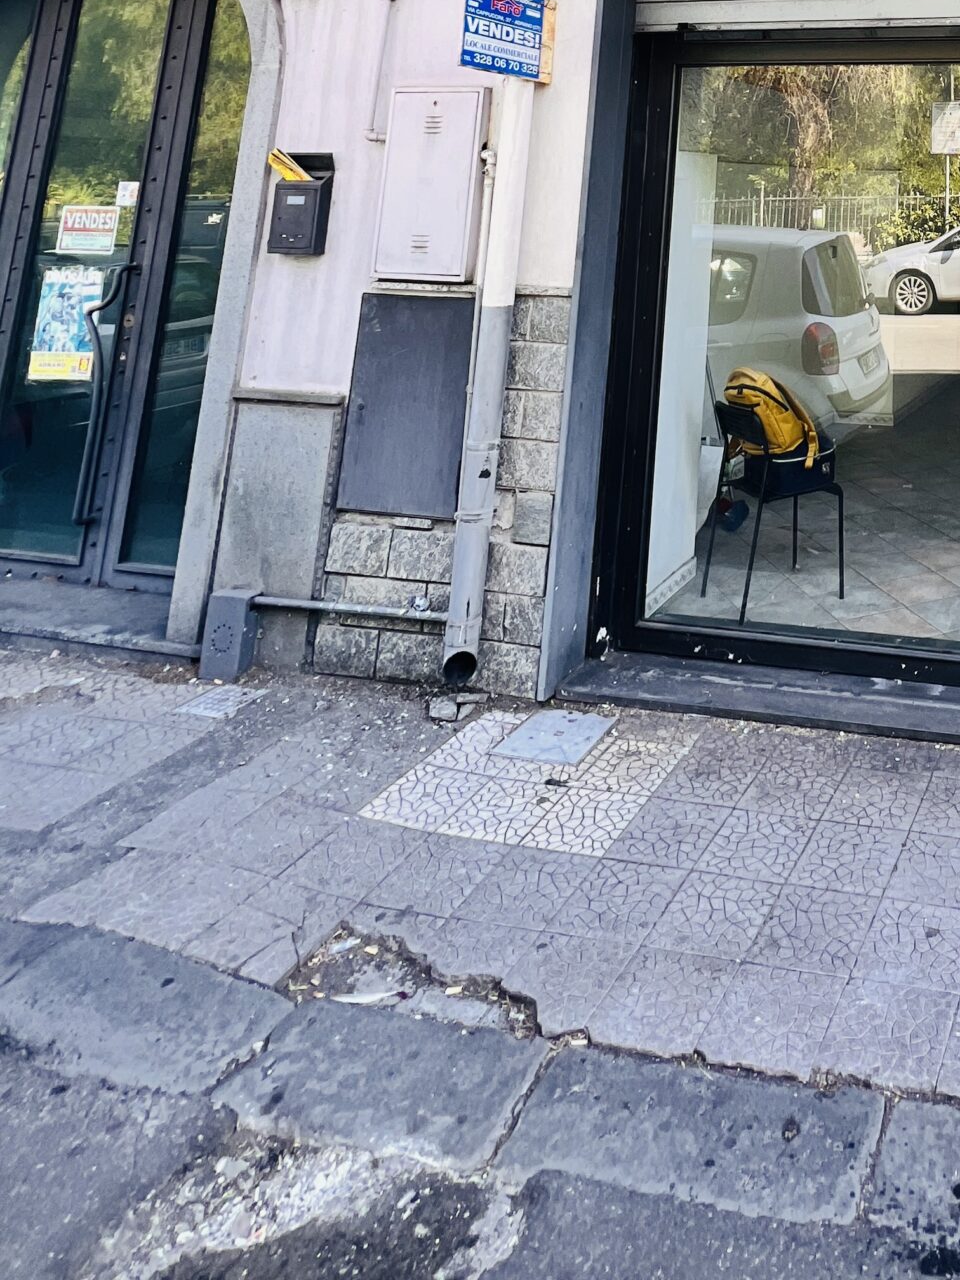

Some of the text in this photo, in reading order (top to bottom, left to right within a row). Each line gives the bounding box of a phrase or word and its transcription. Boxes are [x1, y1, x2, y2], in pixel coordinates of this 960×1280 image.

[465, 38, 539, 61] LOCALE COMMERCIALE
[473, 53, 492, 66] 328
[494, 57, 507, 69] 06
[508, 60, 520, 72] 70
[521, 64, 538, 75] 328
[65, 211, 114, 230] VENDESI
